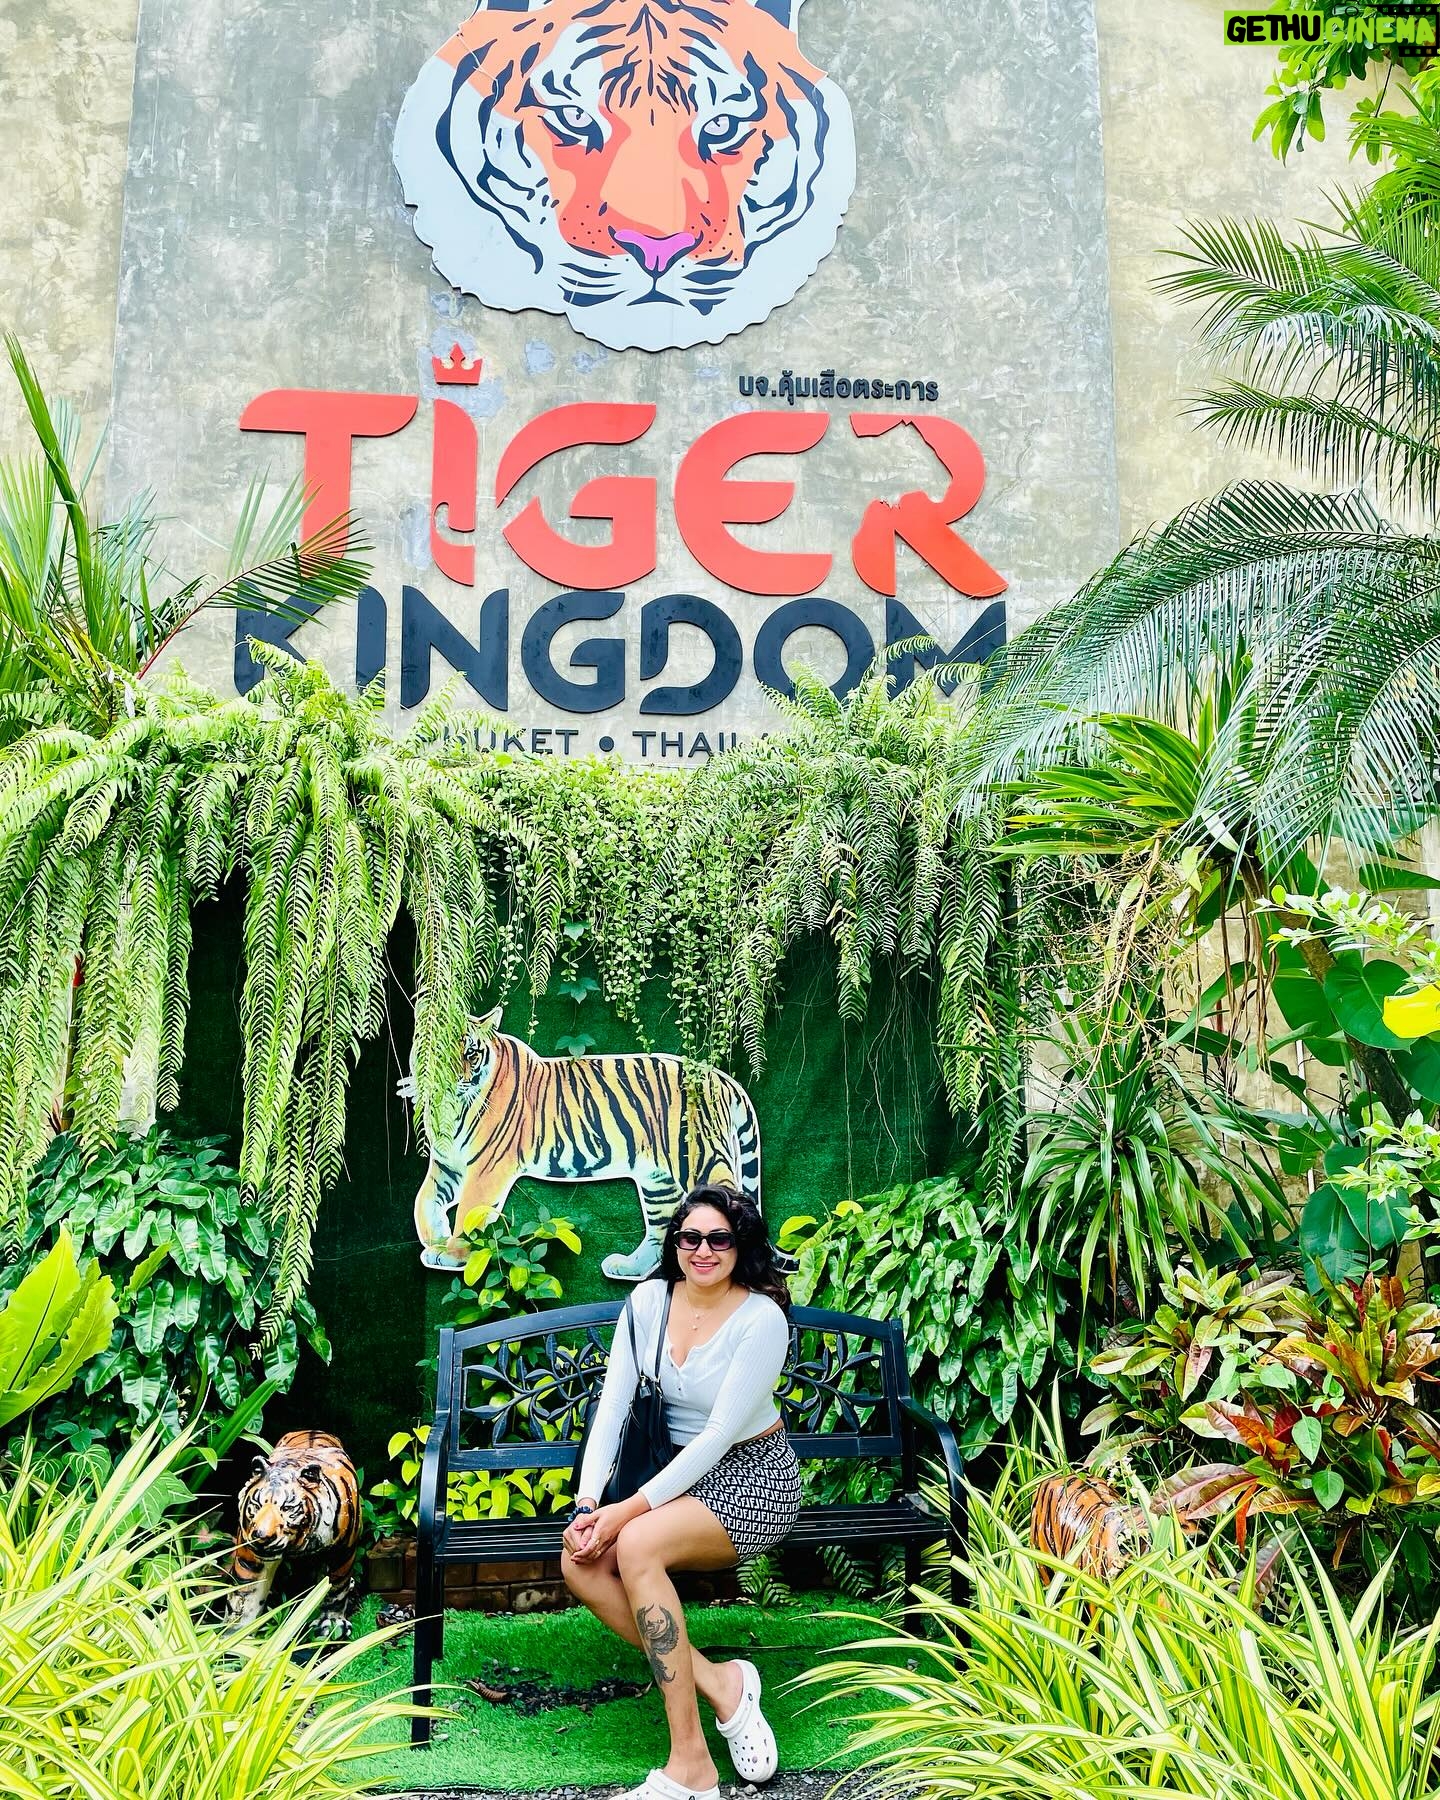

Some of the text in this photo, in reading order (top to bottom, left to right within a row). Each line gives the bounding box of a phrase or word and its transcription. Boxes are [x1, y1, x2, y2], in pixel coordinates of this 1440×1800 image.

[239, 389, 1010, 598] TIGER
[234, 579, 1008, 716] KINGDOM
[416, 726, 580, 756] UKET
